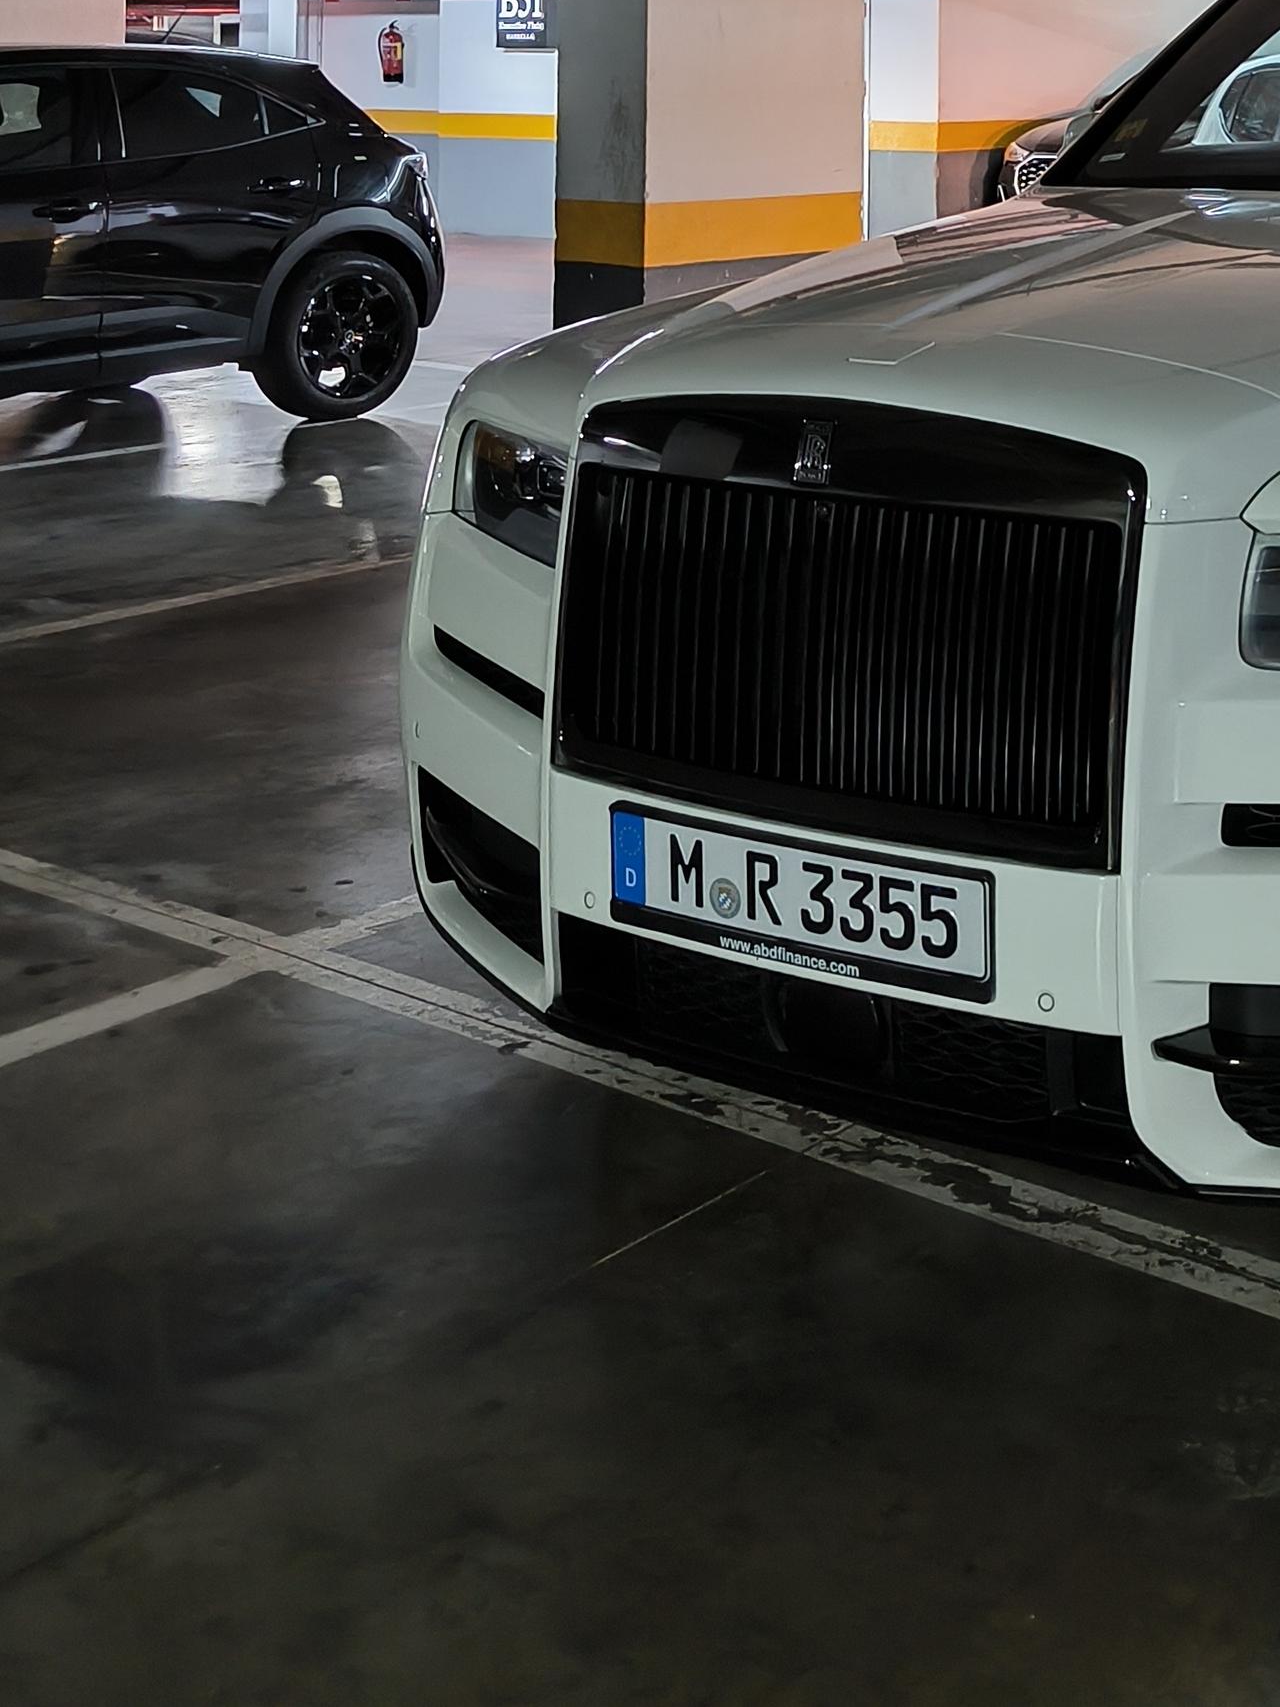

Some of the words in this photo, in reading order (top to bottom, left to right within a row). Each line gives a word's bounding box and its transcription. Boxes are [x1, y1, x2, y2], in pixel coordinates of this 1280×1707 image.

[625, 866, 637, 887] D
[669, 833, 704, 908] M
[745, 850, 782, 926] R
[800, 861, 959, 959] 3355
[719, 935, 860, 978] www.abdfinance.com
